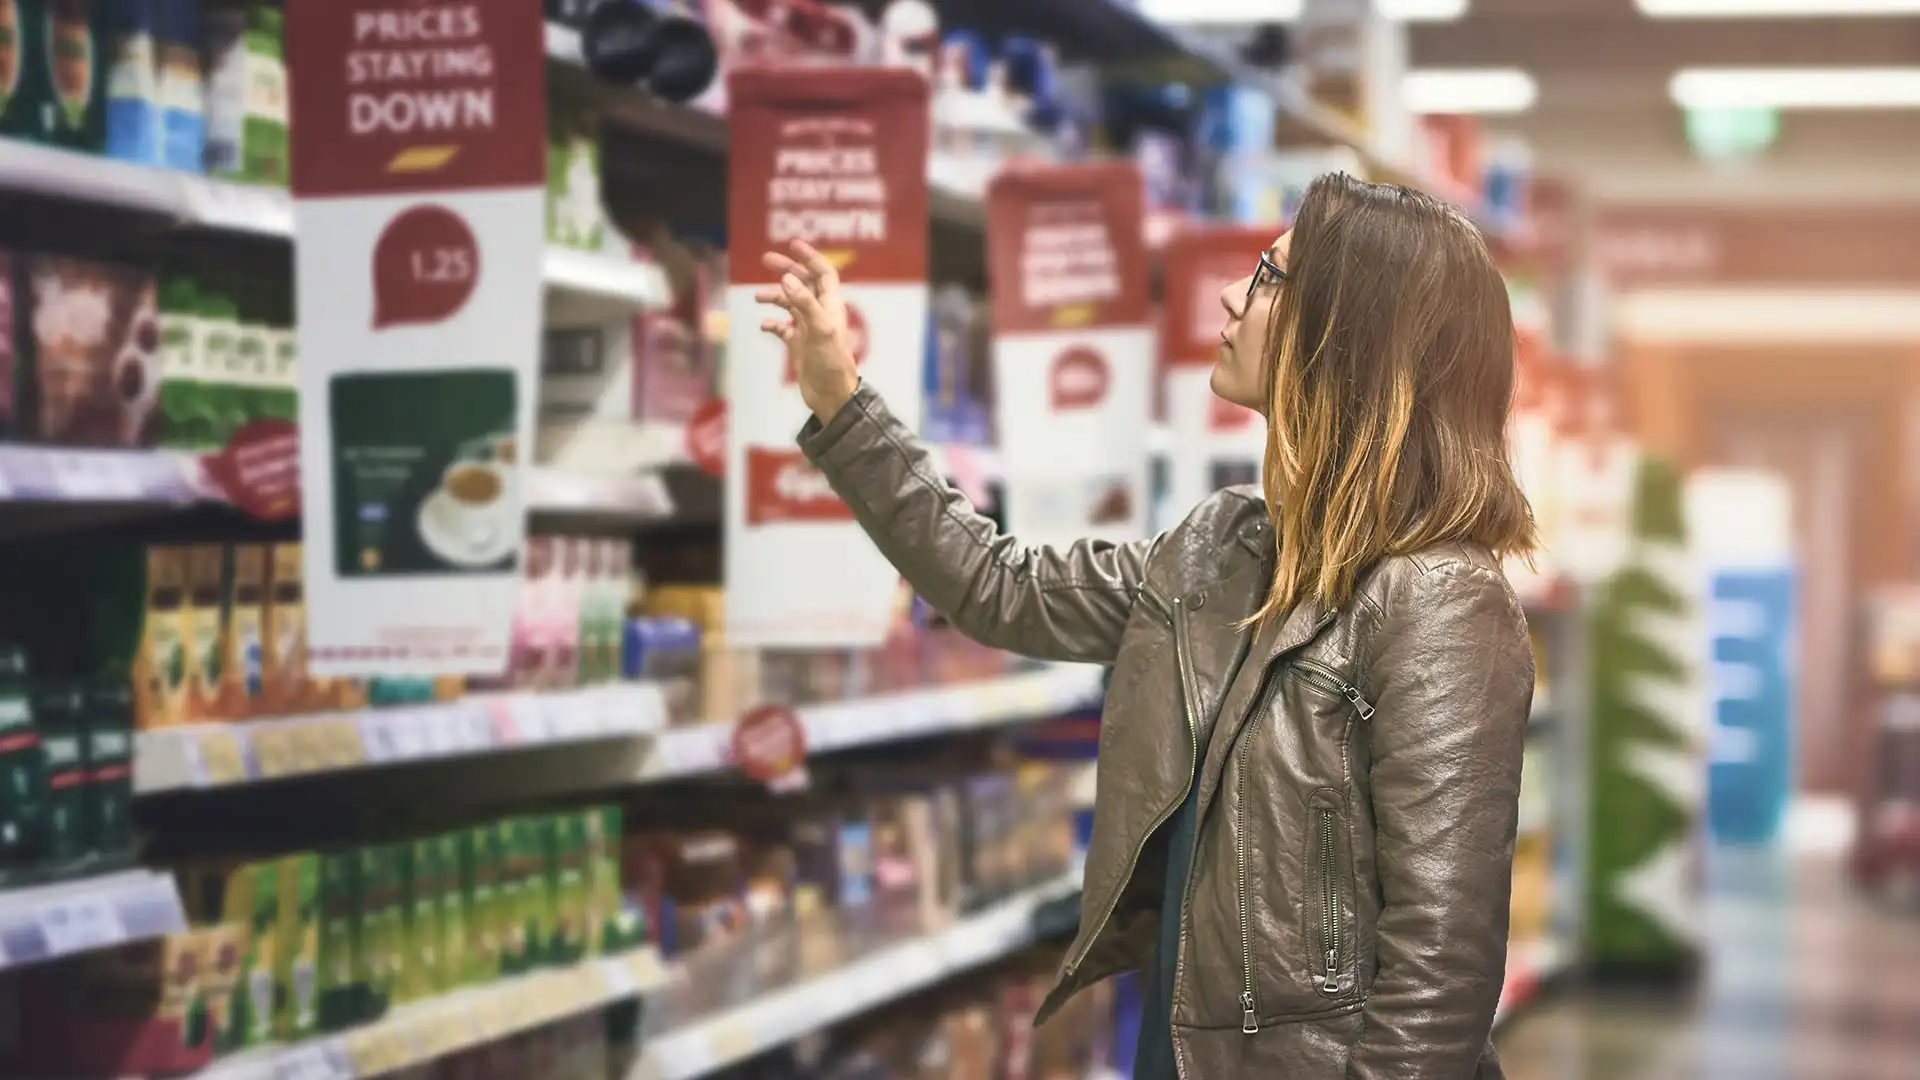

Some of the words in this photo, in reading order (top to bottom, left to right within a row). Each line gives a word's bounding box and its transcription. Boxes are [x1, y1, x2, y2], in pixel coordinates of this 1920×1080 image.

[354, 5, 480, 40] PRICES
[346, 45, 493, 83] STAYING
[349, 89, 494, 134] DOWN
[776, 148, 877, 173] PRICES
[768, 175, 887, 202] STAYING
[768, 209, 886, 243] DOWN
[410, 247, 471, 281] 1.25
